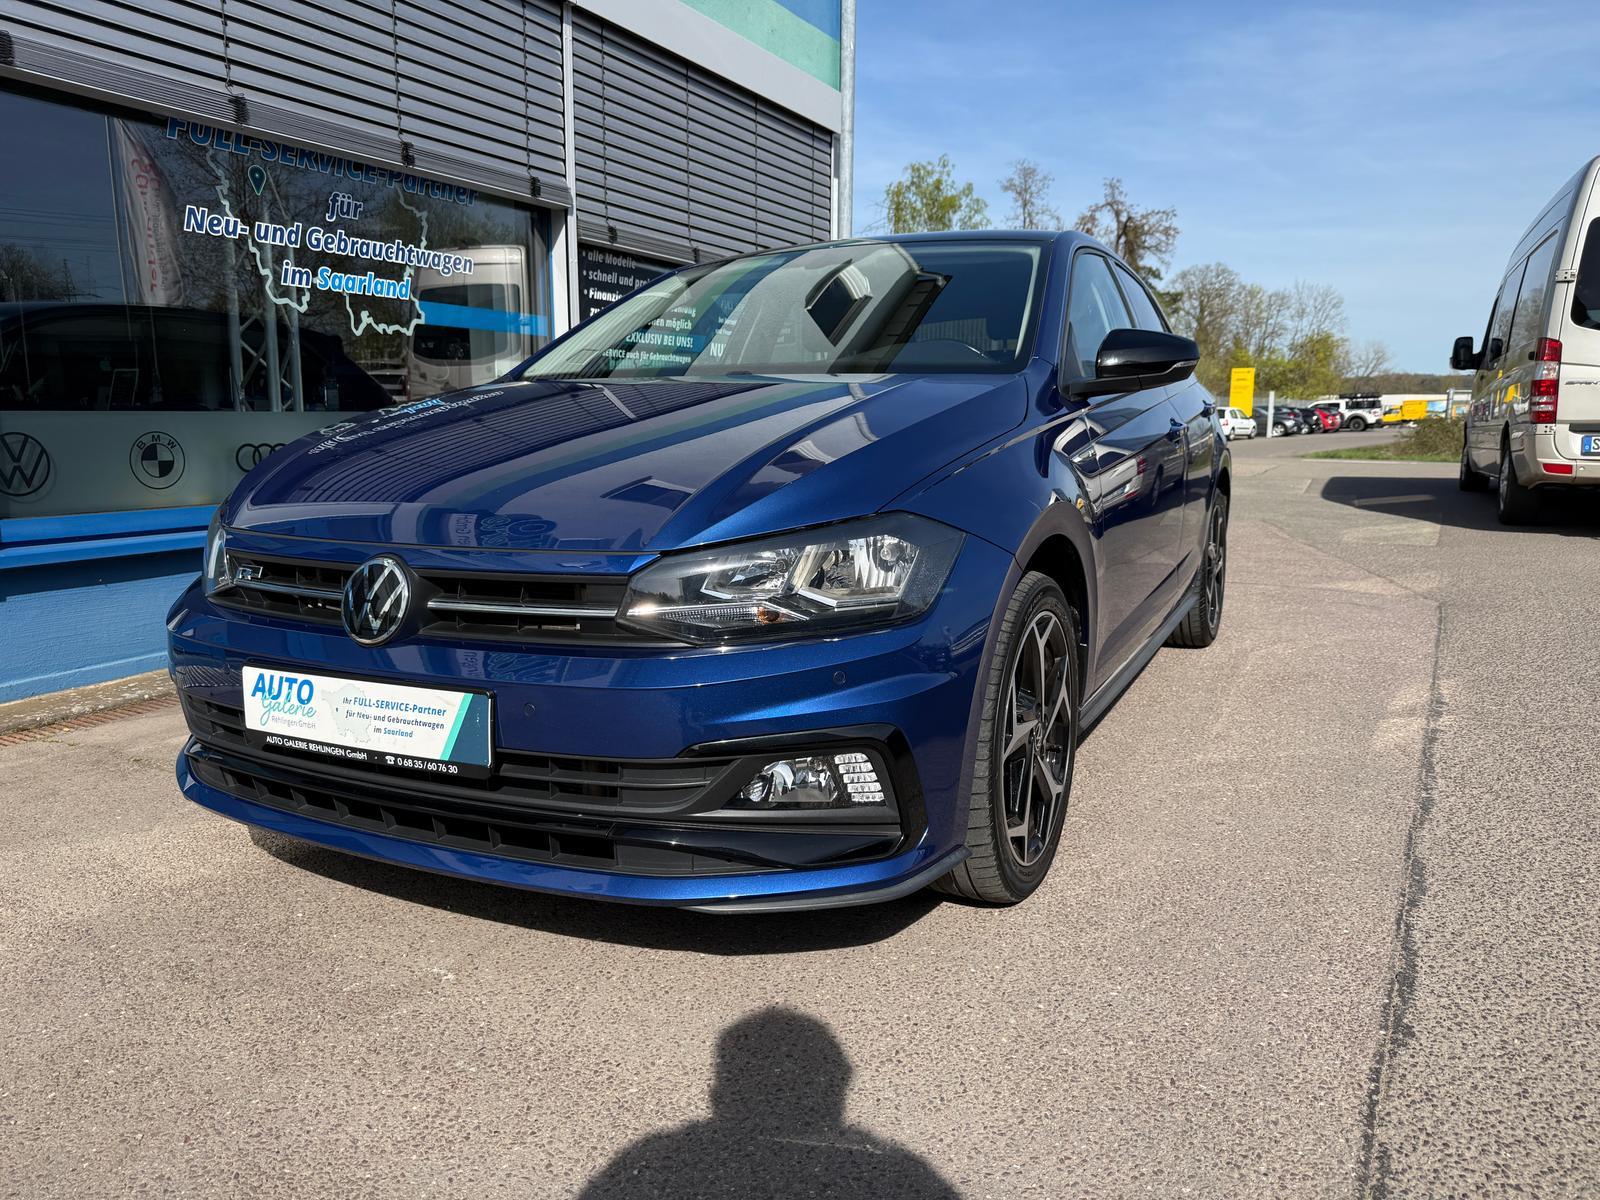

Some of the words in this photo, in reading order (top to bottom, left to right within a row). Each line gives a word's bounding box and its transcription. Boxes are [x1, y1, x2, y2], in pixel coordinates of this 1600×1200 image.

[325, 192, 363, 221] für
[183, 205, 249, 238] Neu-
[255, 222, 302, 248] und
[307, 227, 474, 275] Gebrauchtwagen
[587, 250, 604, 263] alle
[605, 253, 637, 269] Modelle
[281, 260, 311, 288] im
[317, 267, 411, 300] Saarland
[588, 269, 618, 284] schnell
[619, 275, 634, 287] und
[665, 317, 692, 332] möglich
[663, 334, 675, 346] BEI
[676, 336, 693, 348] UNS!
[640, 351, 650, 361] für
[650, 353, 692, 364] Gebrauchtwagen
[251, 673, 314, 705] AUTO
[343, 697, 352, 705] Ihr
[353, 697, 447, 717] FULL-SERVICE-Partner
[345, 710, 355, 718] für
[356, 711, 372, 719] Neu-
[387, 716, 445, 730] Gebrauchtwagen
[373, 726, 382, 734] im
[383, 727, 414, 738] Saarland
[266, 735, 283, 745] AUTO
[284, 738, 308, 750] GALERIE
[308, 742, 345, 757] REHLINGEN
[346, 749, 368, 760] GmbH
